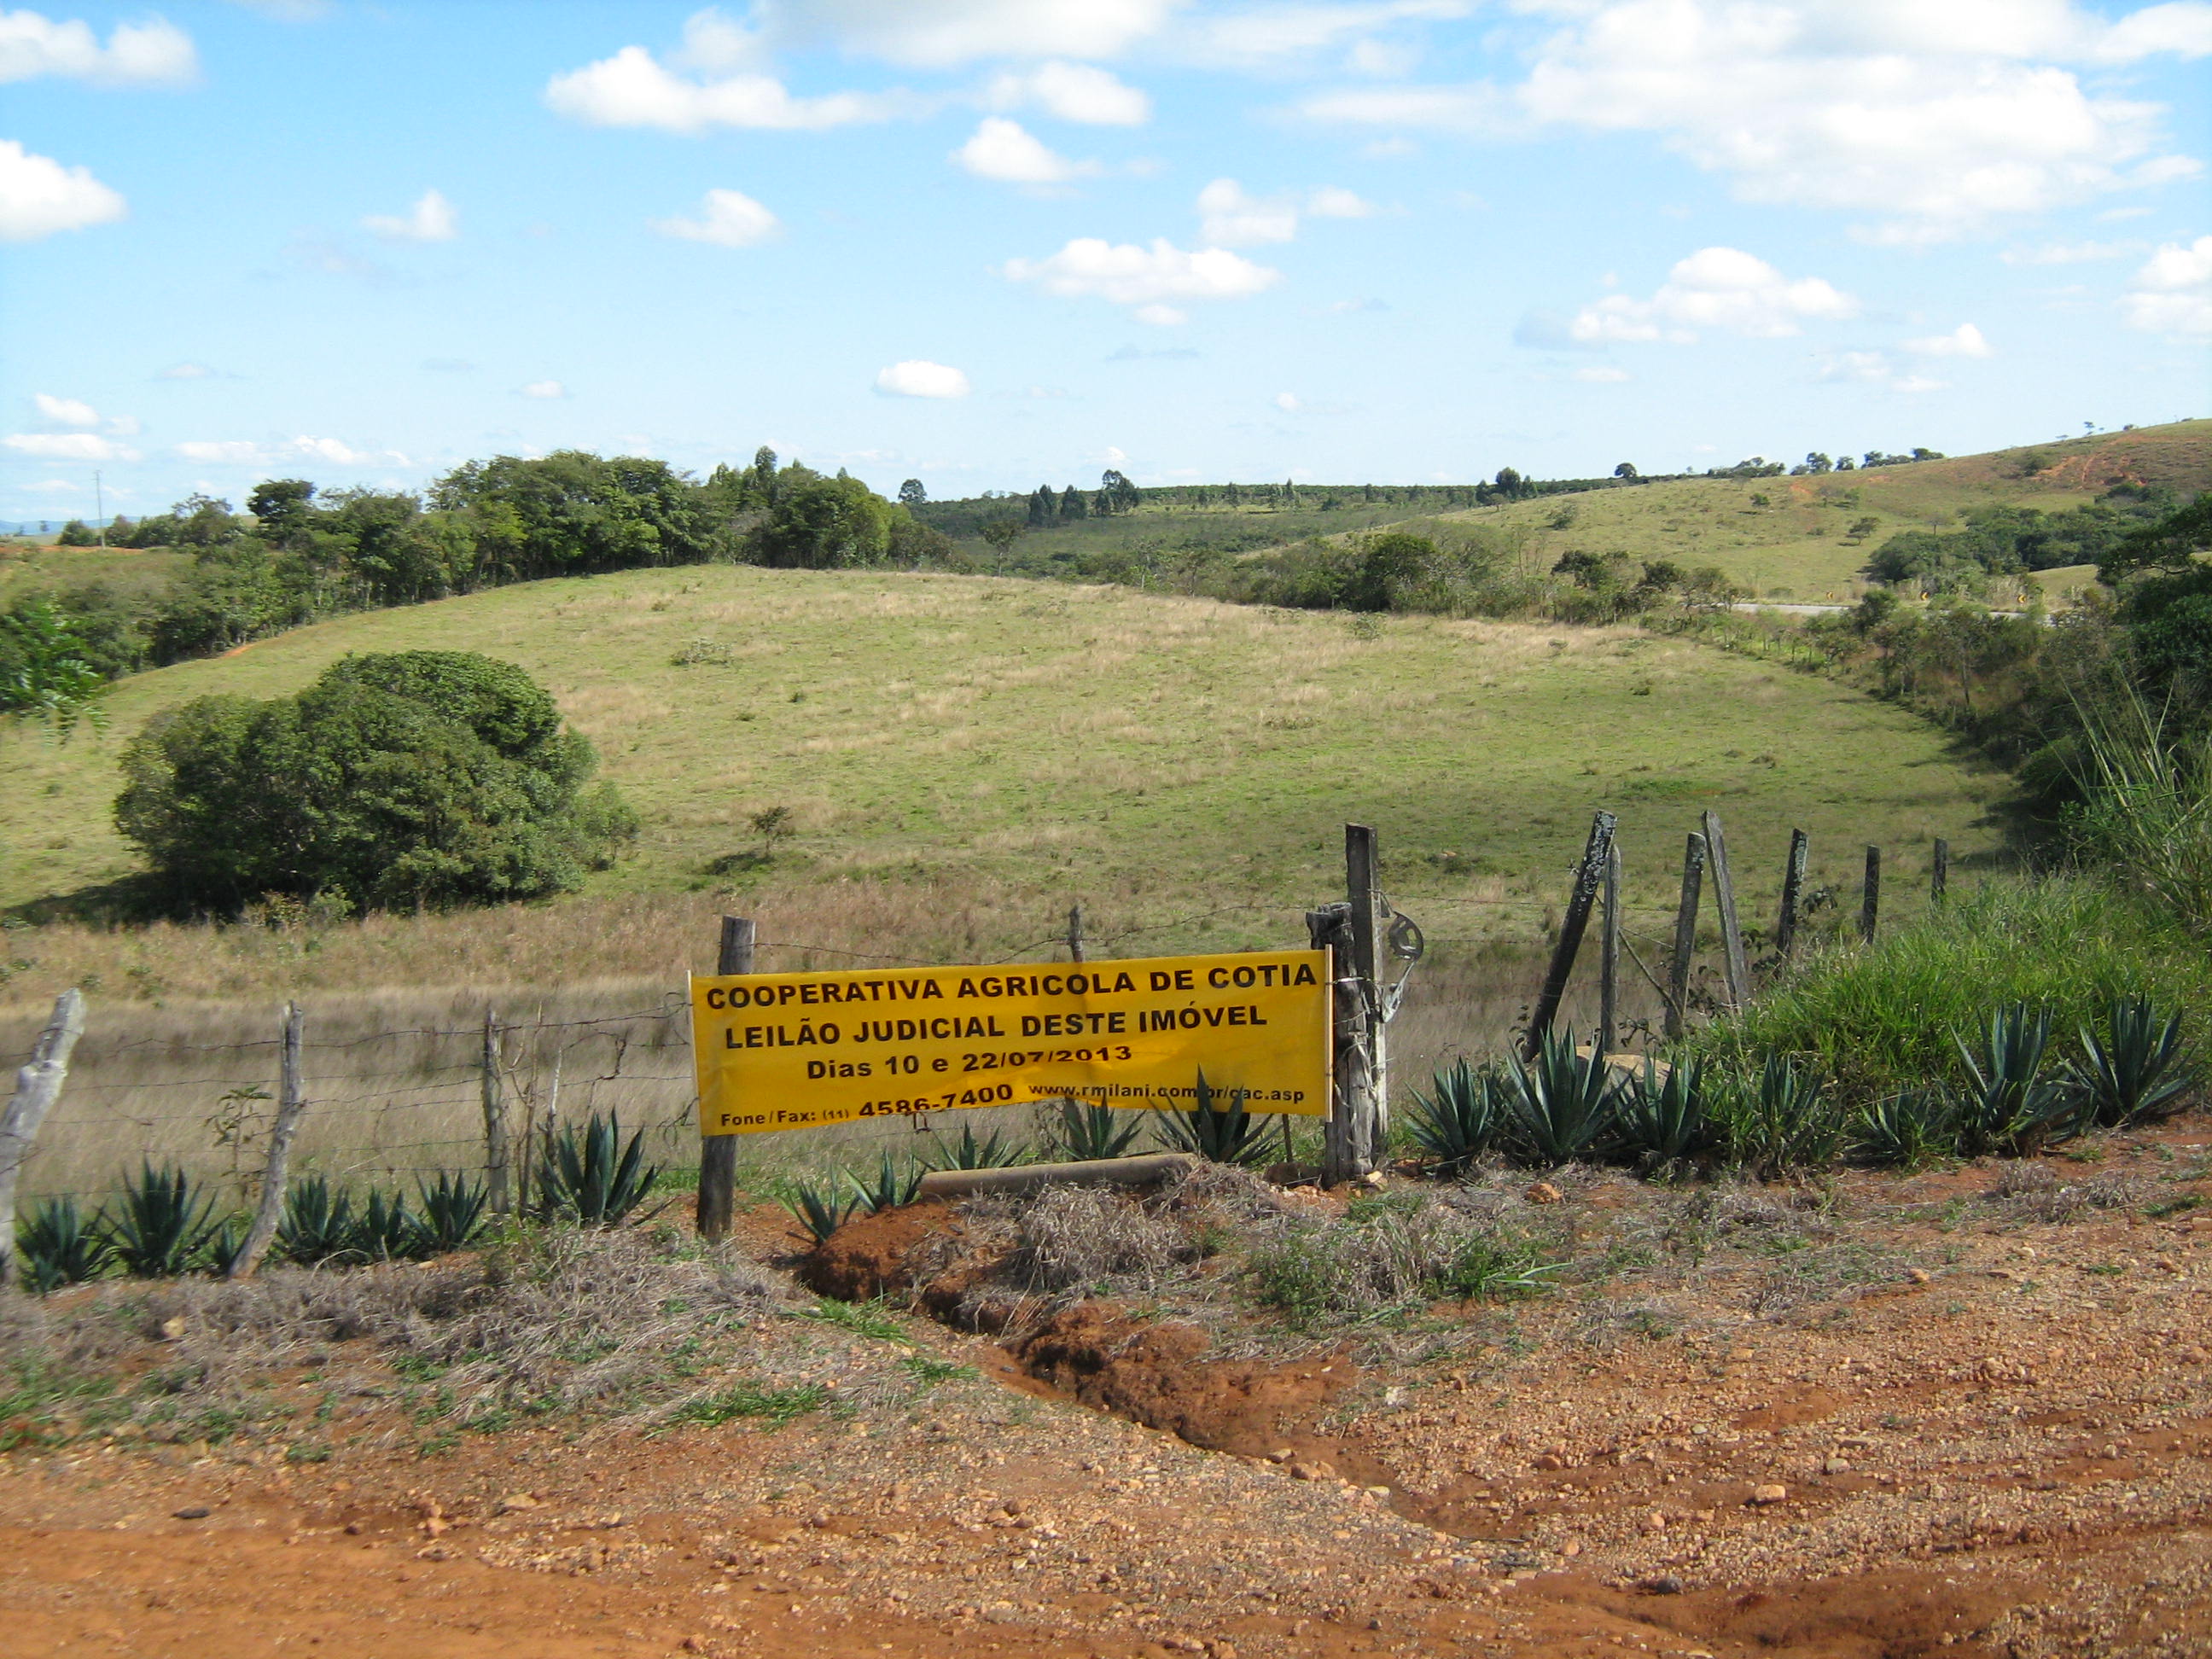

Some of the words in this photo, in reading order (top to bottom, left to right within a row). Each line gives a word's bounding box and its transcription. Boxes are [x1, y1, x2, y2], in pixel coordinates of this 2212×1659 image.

[707, 979, 944, 1010] COOPERATIVA
[958, 972, 1137, 998] AGRICOLA
[1150, 969, 1194, 991] DE
[1208, 963, 1317, 988] COTIA
[725, 1017, 841, 1049] LEILÃO
[853, 1016, 1005, 1043] JUDICIAL
[1022, 1012, 1126, 1037] DESTE
[1139, 1000, 1267, 1033] IMÓVEL
[806, 1059, 872, 1080] Dias
[884, 1055, 919, 1074] 10
[932, 1058, 948, 1072] e
[962, 1045, 1132, 1072] 22/07/2013
[823, 1109, 850, 1120] (11)
[859, 1084, 1013, 1116] 4586-7400
[1028, 1084, 1304, 1103] www.rmilani.combr/cac.asp
